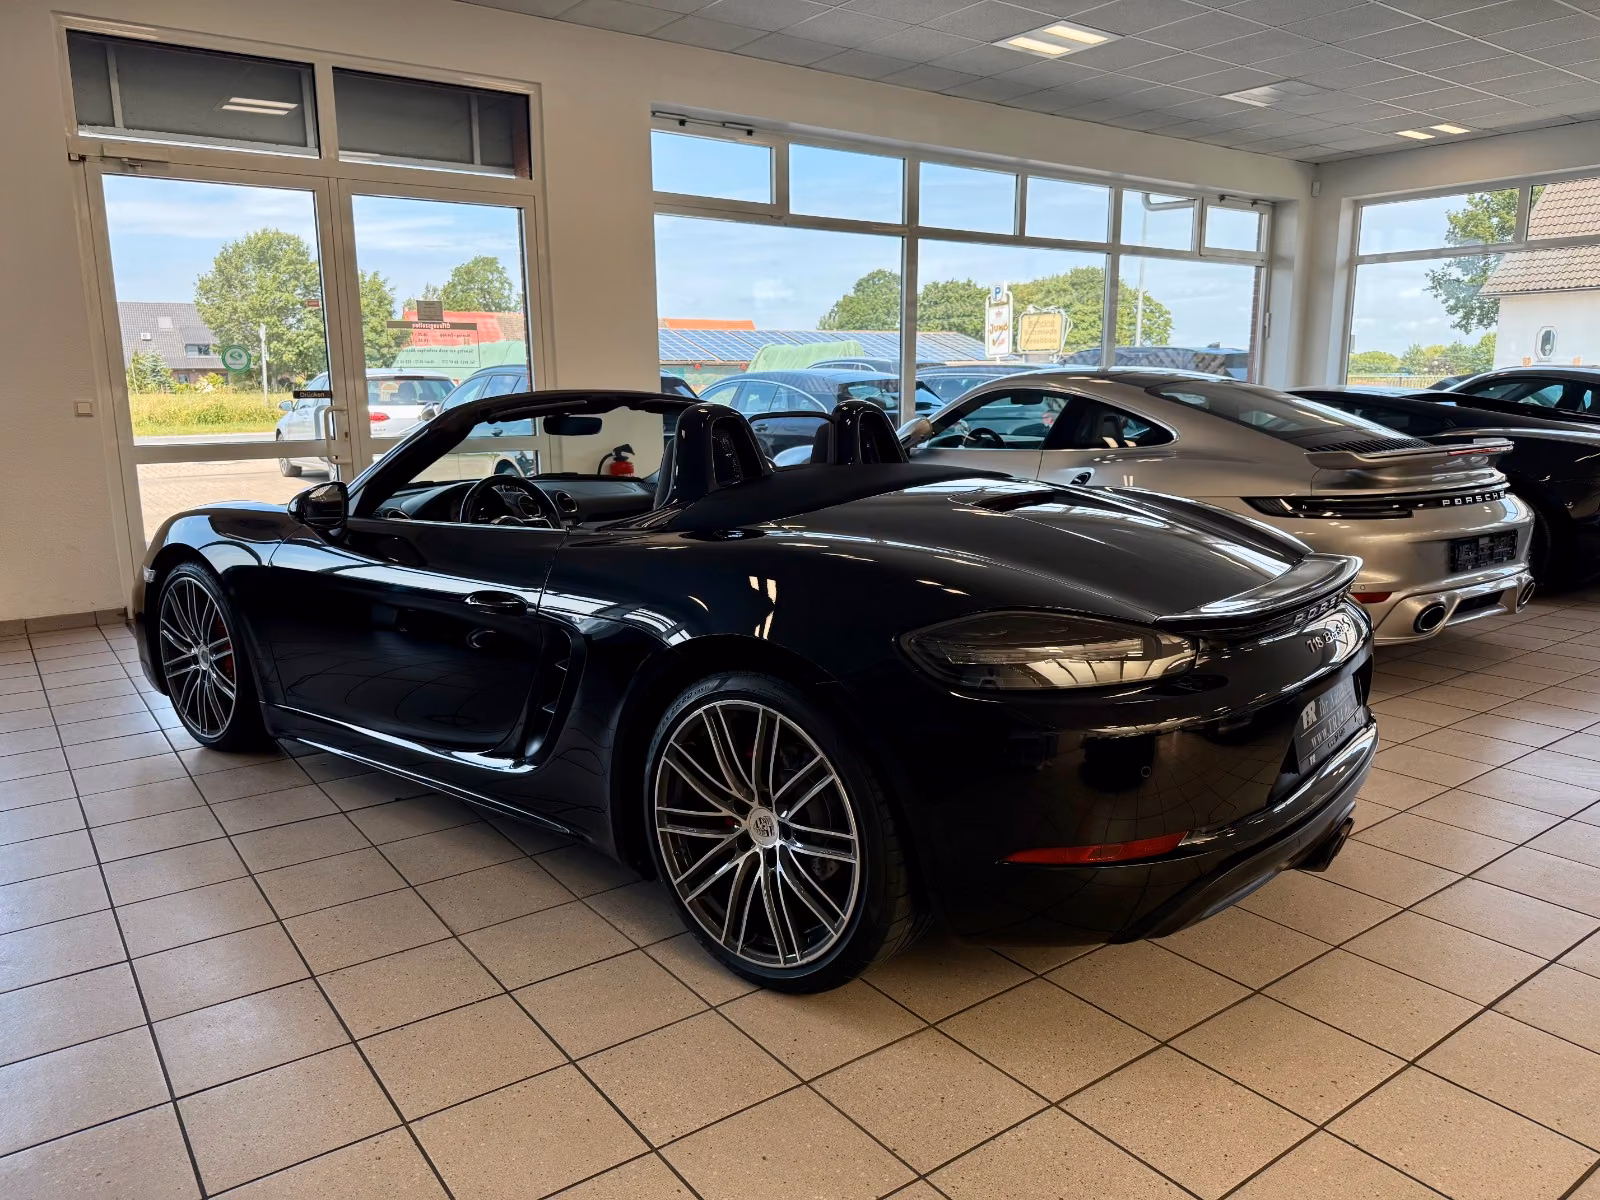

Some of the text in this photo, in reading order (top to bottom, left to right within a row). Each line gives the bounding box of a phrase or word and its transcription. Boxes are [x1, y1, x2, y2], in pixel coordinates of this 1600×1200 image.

[994, 287, 1001, 299] P
[1442, 491, 1505, 506] PORSCHE
[1305, 636, 1324, 654] 718
